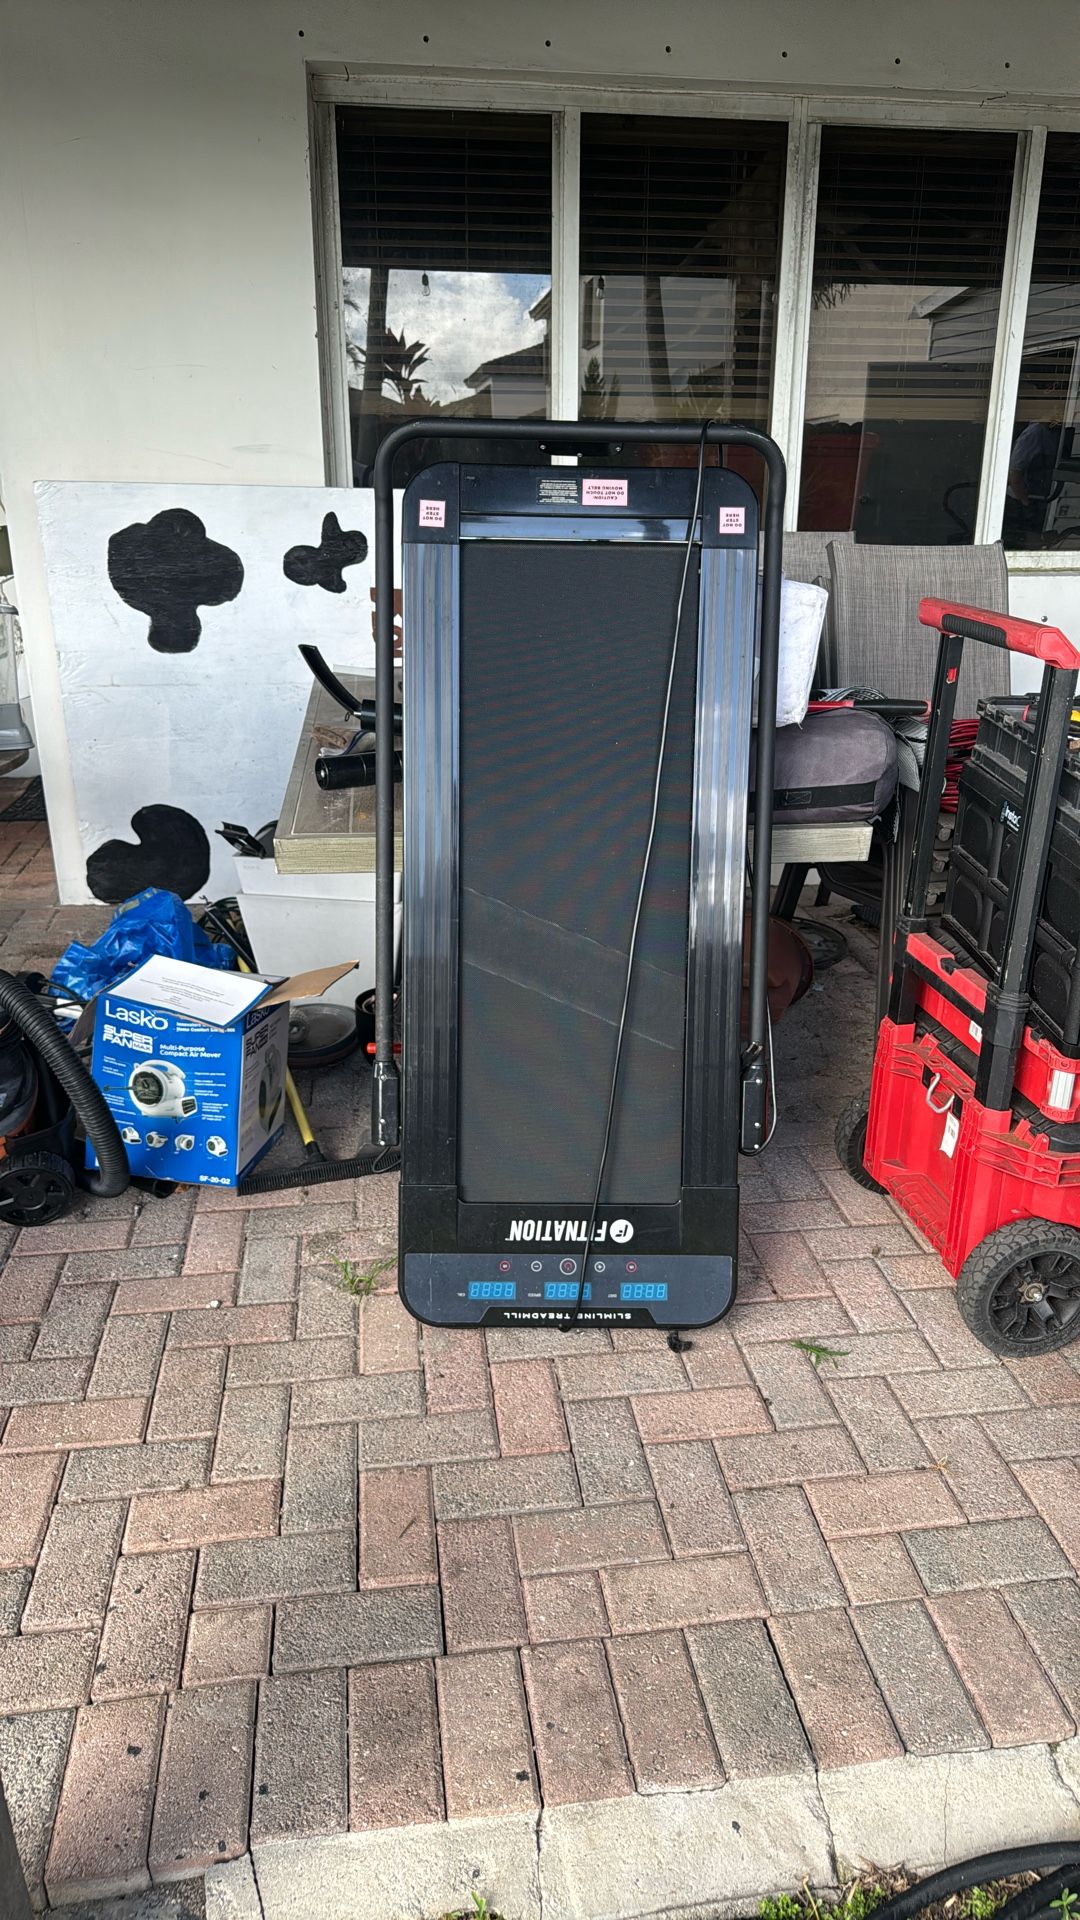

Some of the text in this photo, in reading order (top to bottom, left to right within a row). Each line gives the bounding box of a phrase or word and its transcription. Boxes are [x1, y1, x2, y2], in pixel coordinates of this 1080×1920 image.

[105, 1000, 169, 1030] Lasko
[103, 1024, 153, 1046] SUPER
[103, 1032, 132, 1049] FAN
[160, 1044, 205, 1052] Multi-Purpose
[504, 1312, 632, 1320] SLIMLINE TREADMILL
